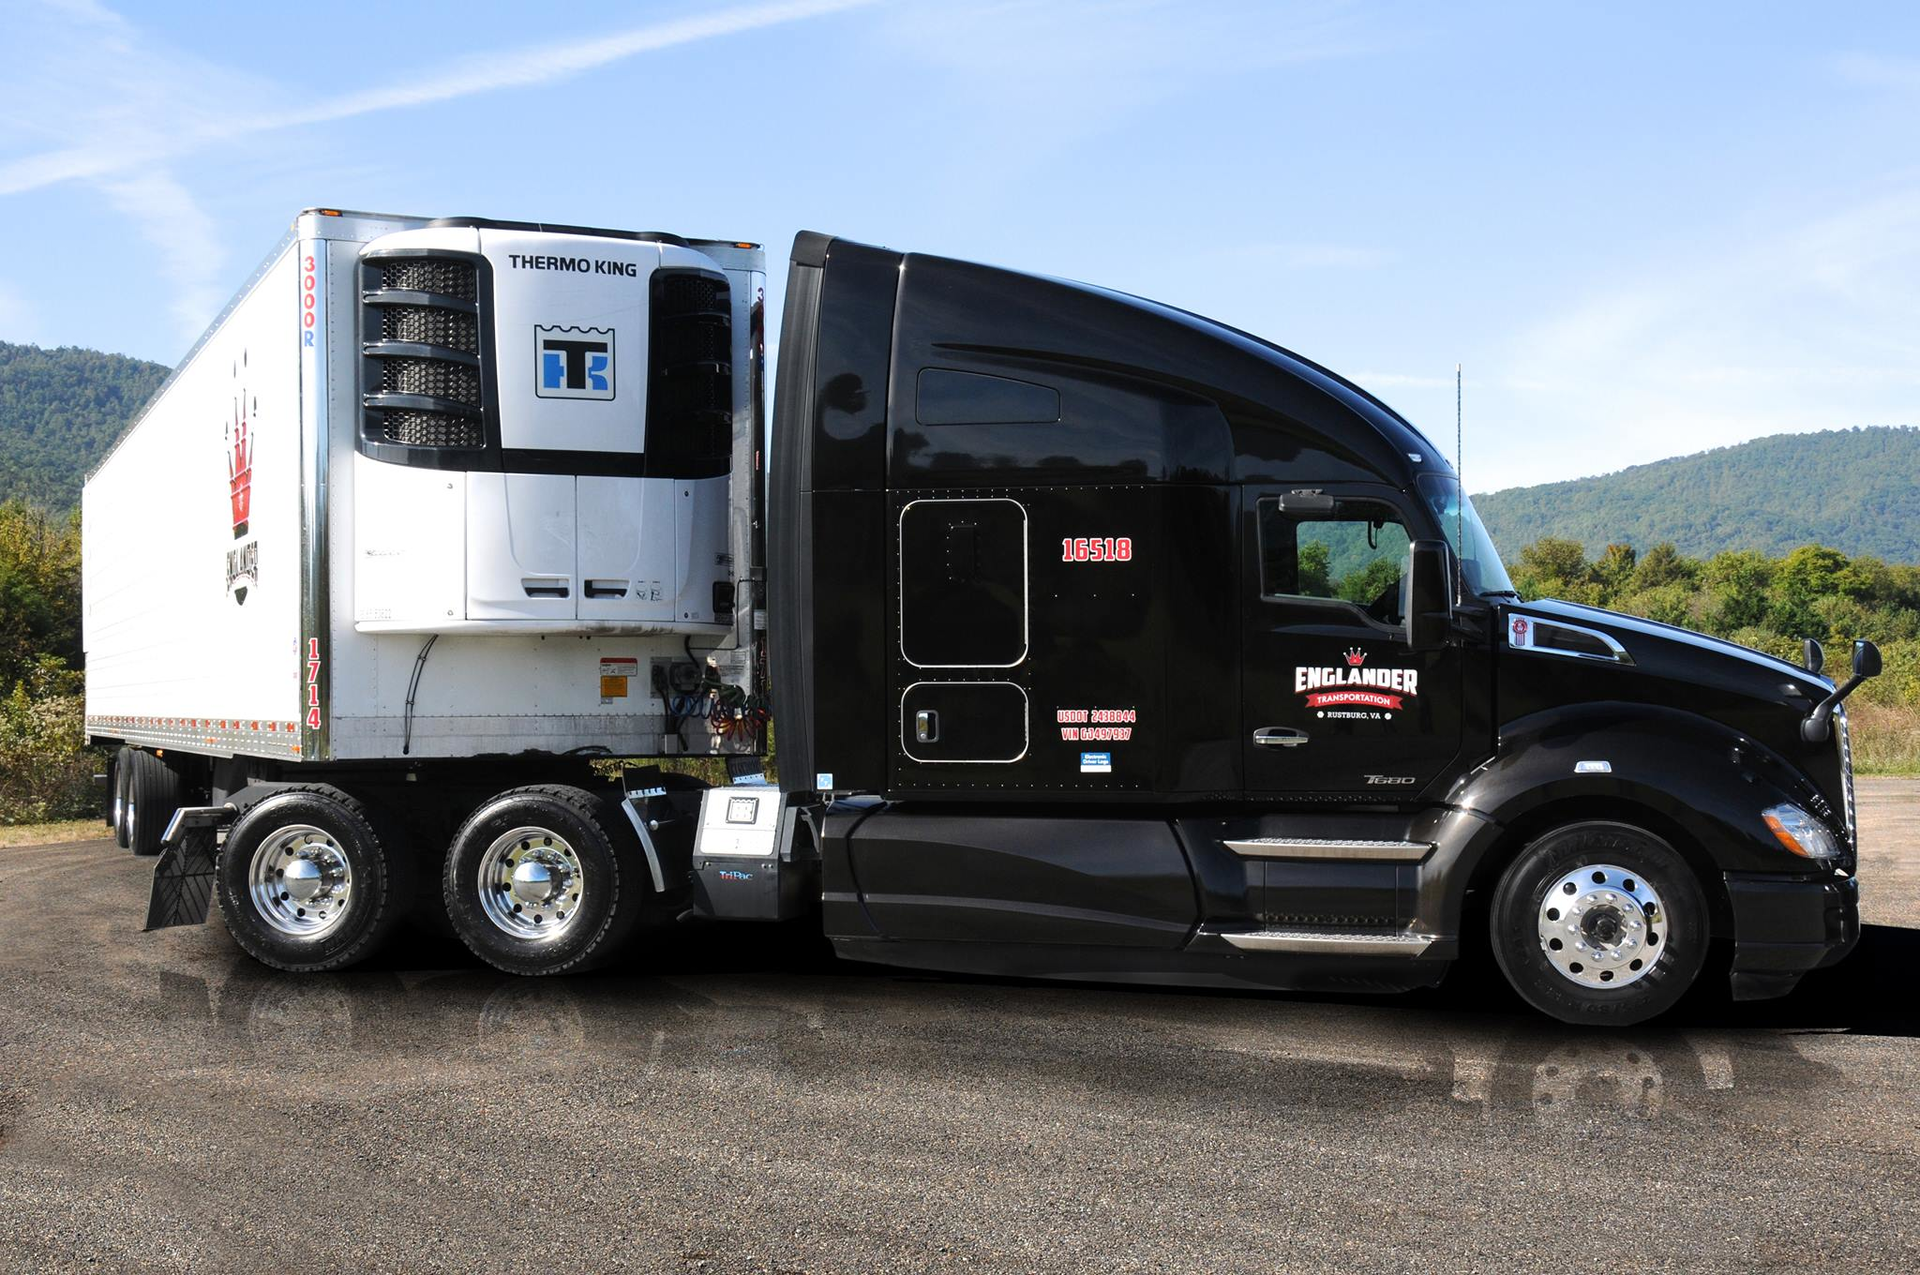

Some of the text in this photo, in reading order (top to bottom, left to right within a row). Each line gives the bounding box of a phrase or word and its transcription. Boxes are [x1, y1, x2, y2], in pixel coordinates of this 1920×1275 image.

[509, 254, 637, 277] THERMO KING
[304, 256, 316, 347] 3000R
[1062, 537, 1132, 562] 16518
[306, 637, 321, 730] 1714
[1294, 666, 1418, 696] ENGLANDER
[1317, 693, 1391, 706] TRANSPORTATION
[1057, 710, 1136, 722] USDOT 2438844
[1327, 711, 1369, 720] RUSTBURG,
[1061, 727, 1079, 740] VIN
[1364, 774, 1416, 785] T680
[719, 870, 754, 881] TriPac
